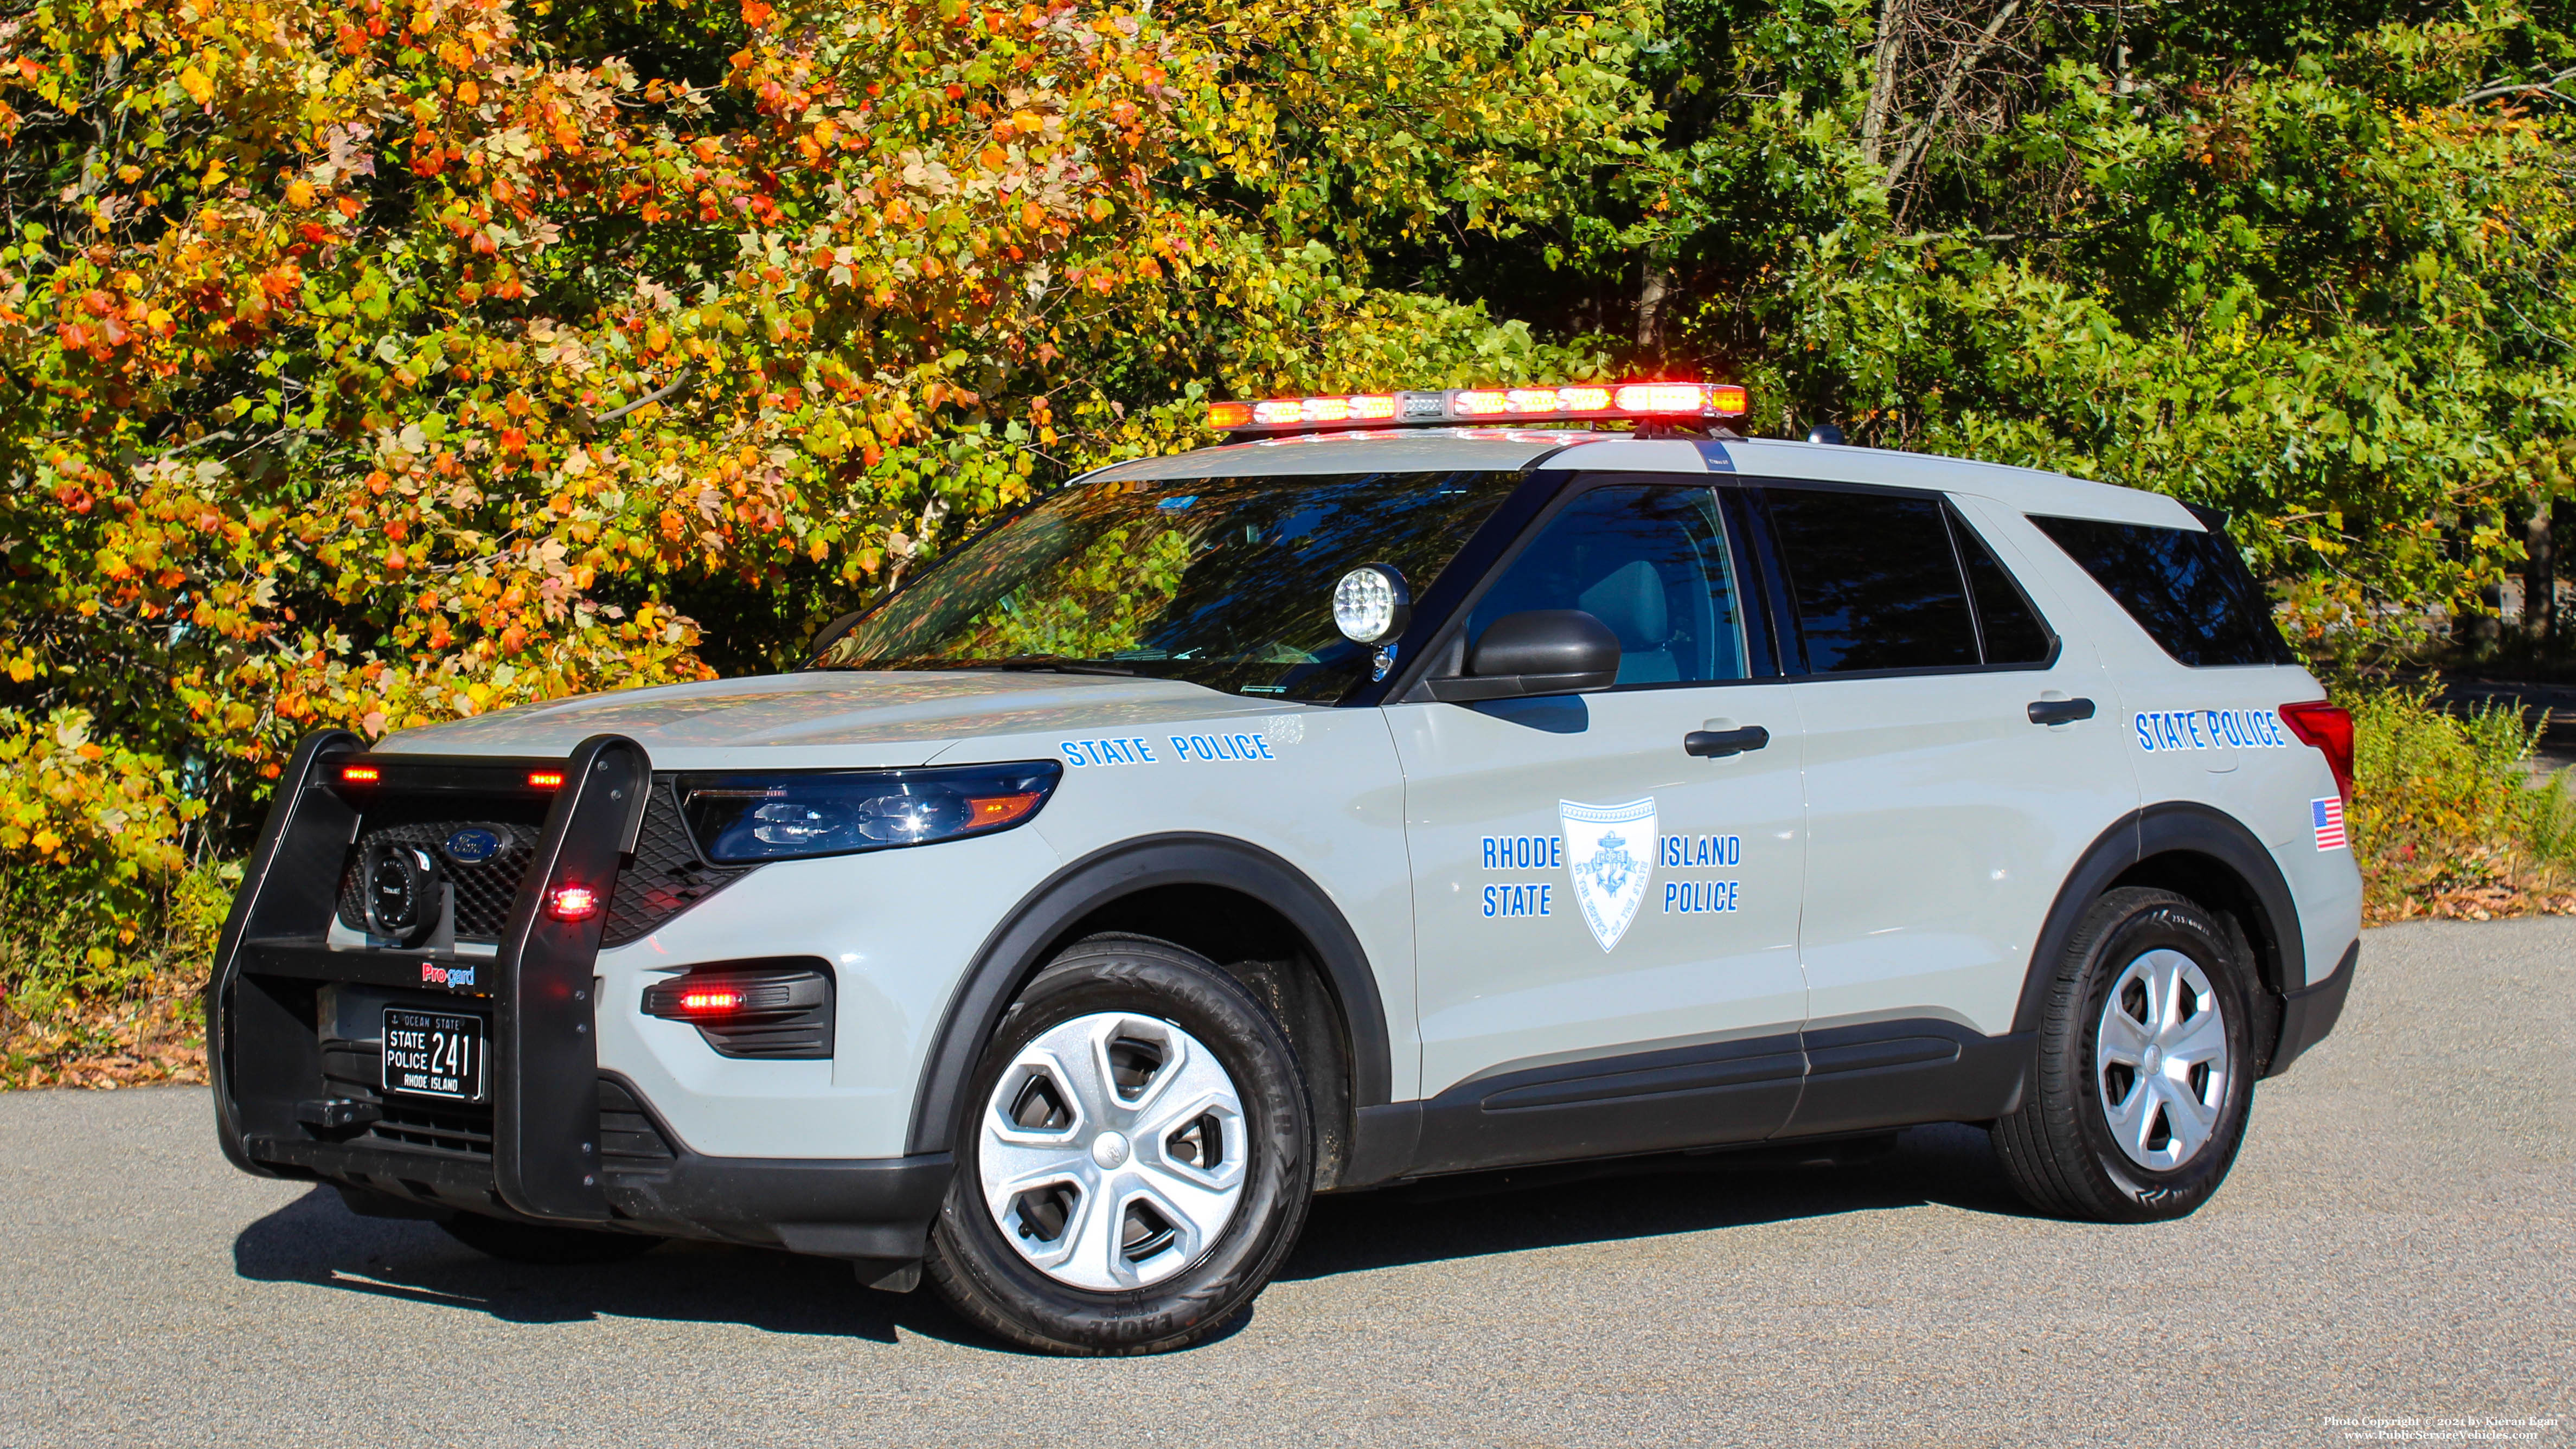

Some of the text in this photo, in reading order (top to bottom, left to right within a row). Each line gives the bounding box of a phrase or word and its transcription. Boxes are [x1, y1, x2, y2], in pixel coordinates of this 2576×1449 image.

[2135, 708, 2286, 753] STATE POLICE
[1060, 733, 1276, 768] STATE POLICE
[455, 833, 486, 854] Ford
[1481, 834, 1741, 870] RHODE ISLAND
[1482, 880, 1739, 918] STATE POLICE
[1579, 876, 1590, 899] THE
[1611, 920, 1620, 935] OF
[1621, 898, 1635, 919] THE
[1633, 861, 1649, 895] STATE
[390, 1030, 426, 1049] STATE
[405, 1015, 460, 1031] OCEAN STATE
[387, 1050, 428, 1070] POLICE
[431, 1032, 469, 1076] 241
[404, 1073, 458, 1092] RHODE ISLAND
